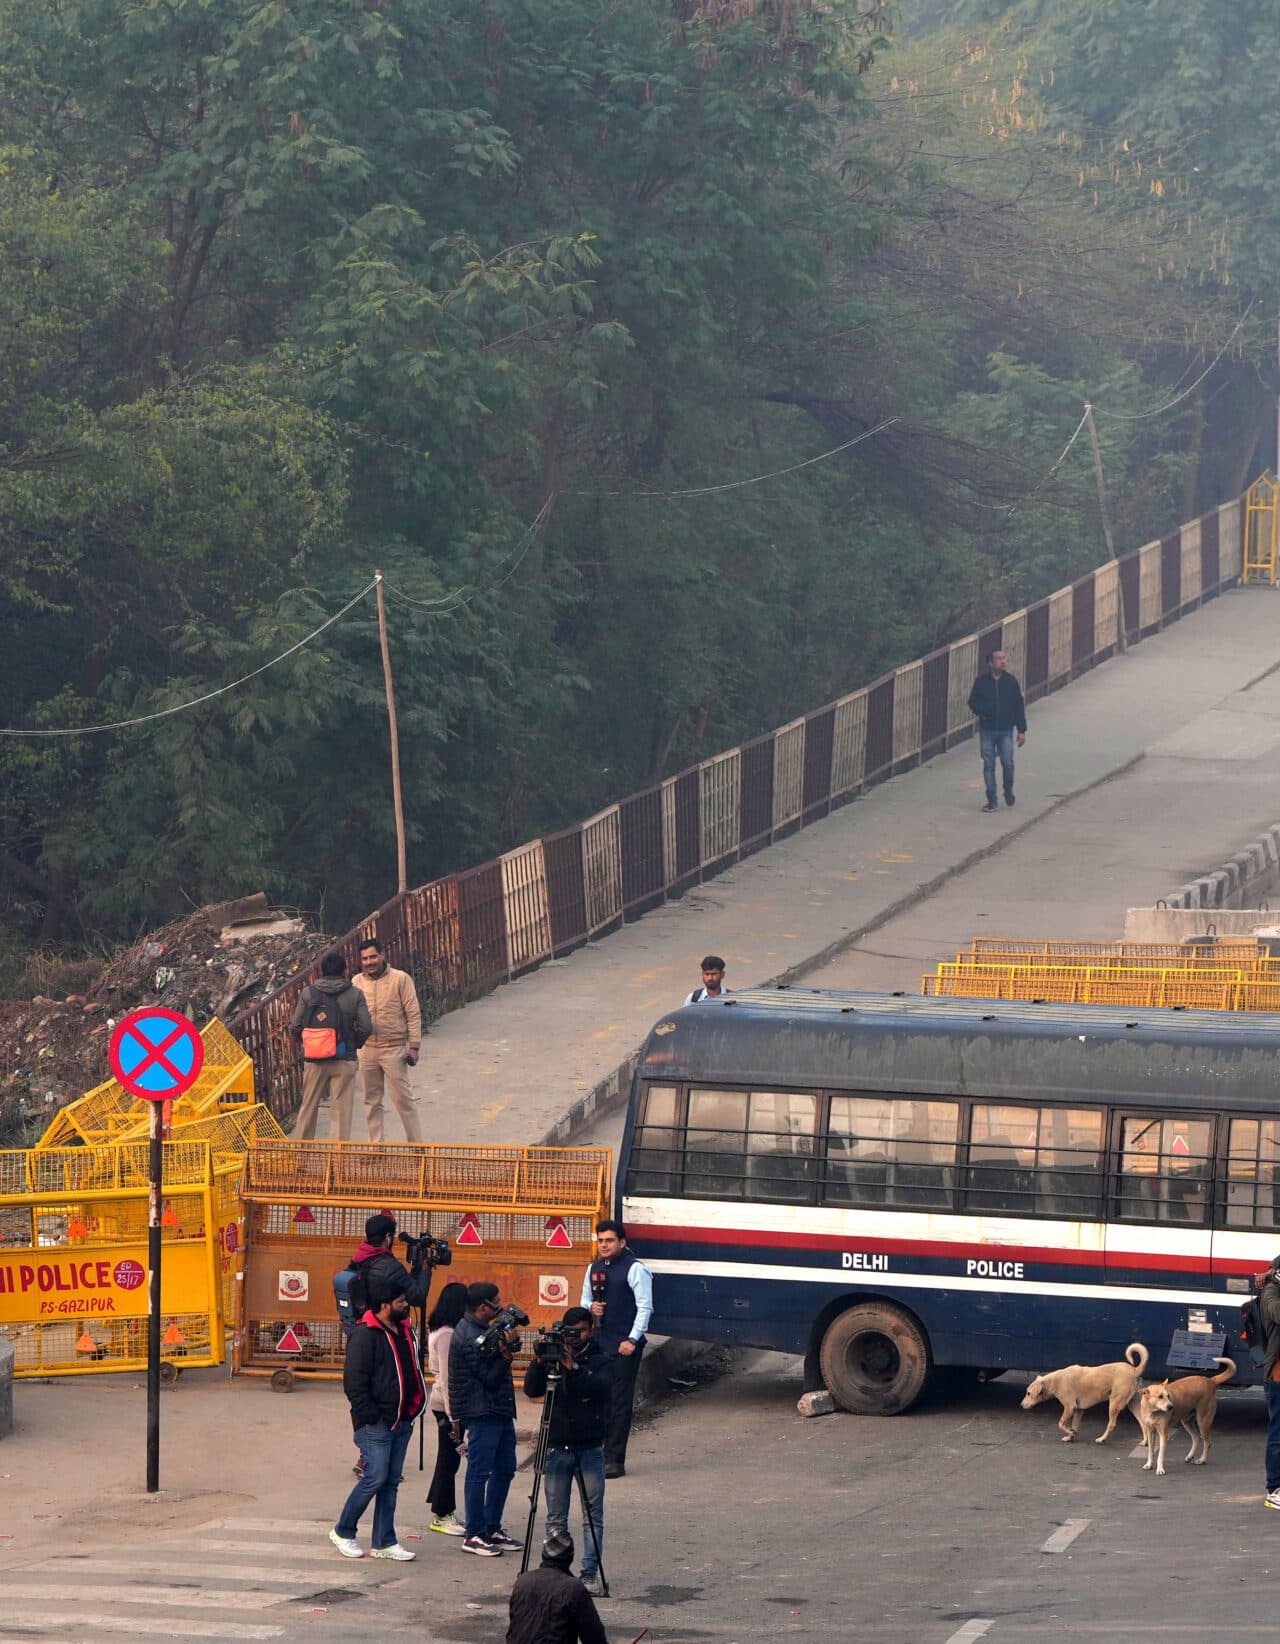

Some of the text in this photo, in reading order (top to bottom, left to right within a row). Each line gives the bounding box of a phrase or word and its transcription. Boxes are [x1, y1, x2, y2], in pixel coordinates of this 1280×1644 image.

[20, 1262, 112, 1292] POLICE
[841, 1253, 1024, 1278] DELHI POLICE
